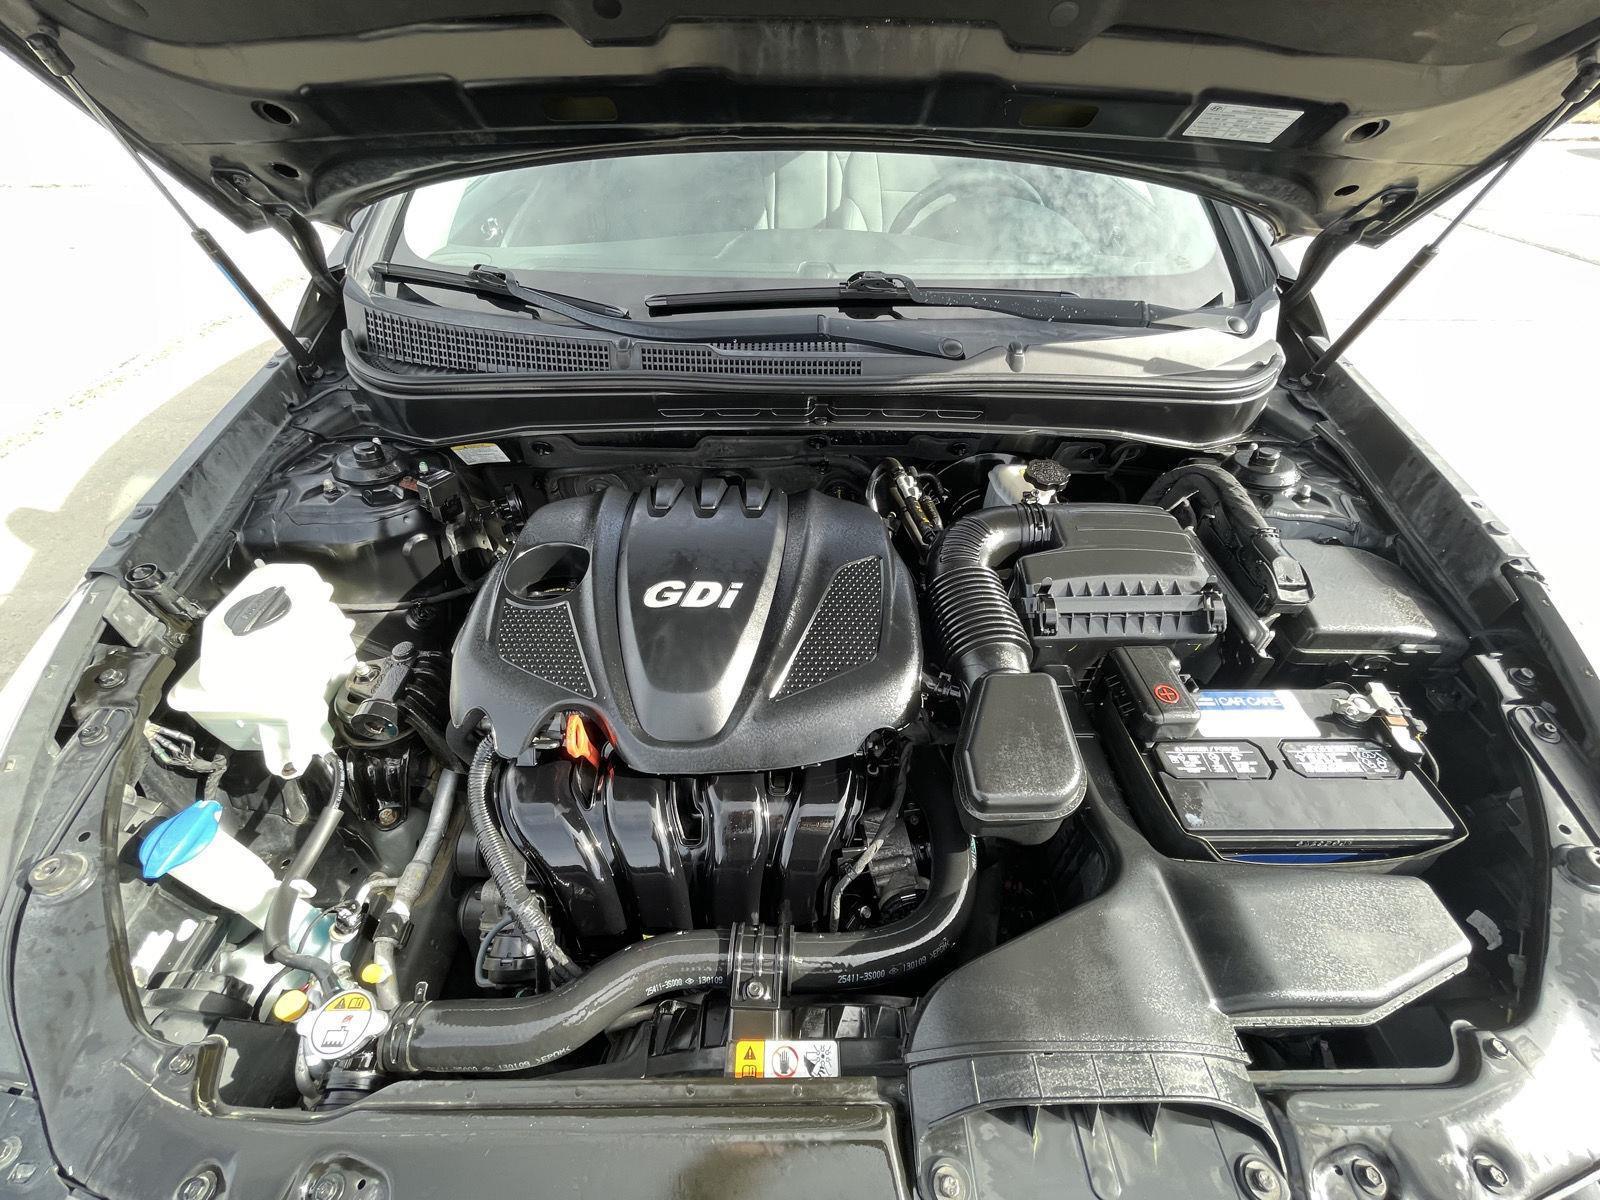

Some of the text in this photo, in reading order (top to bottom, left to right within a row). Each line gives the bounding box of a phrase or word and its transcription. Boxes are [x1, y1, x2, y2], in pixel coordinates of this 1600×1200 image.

[642, 580, 744, 609] GDi
[698, 976, 723, 985] 130109
[838, 969, 886, 984] 25411-3S000
[903, 955, 927, 972] 130109
